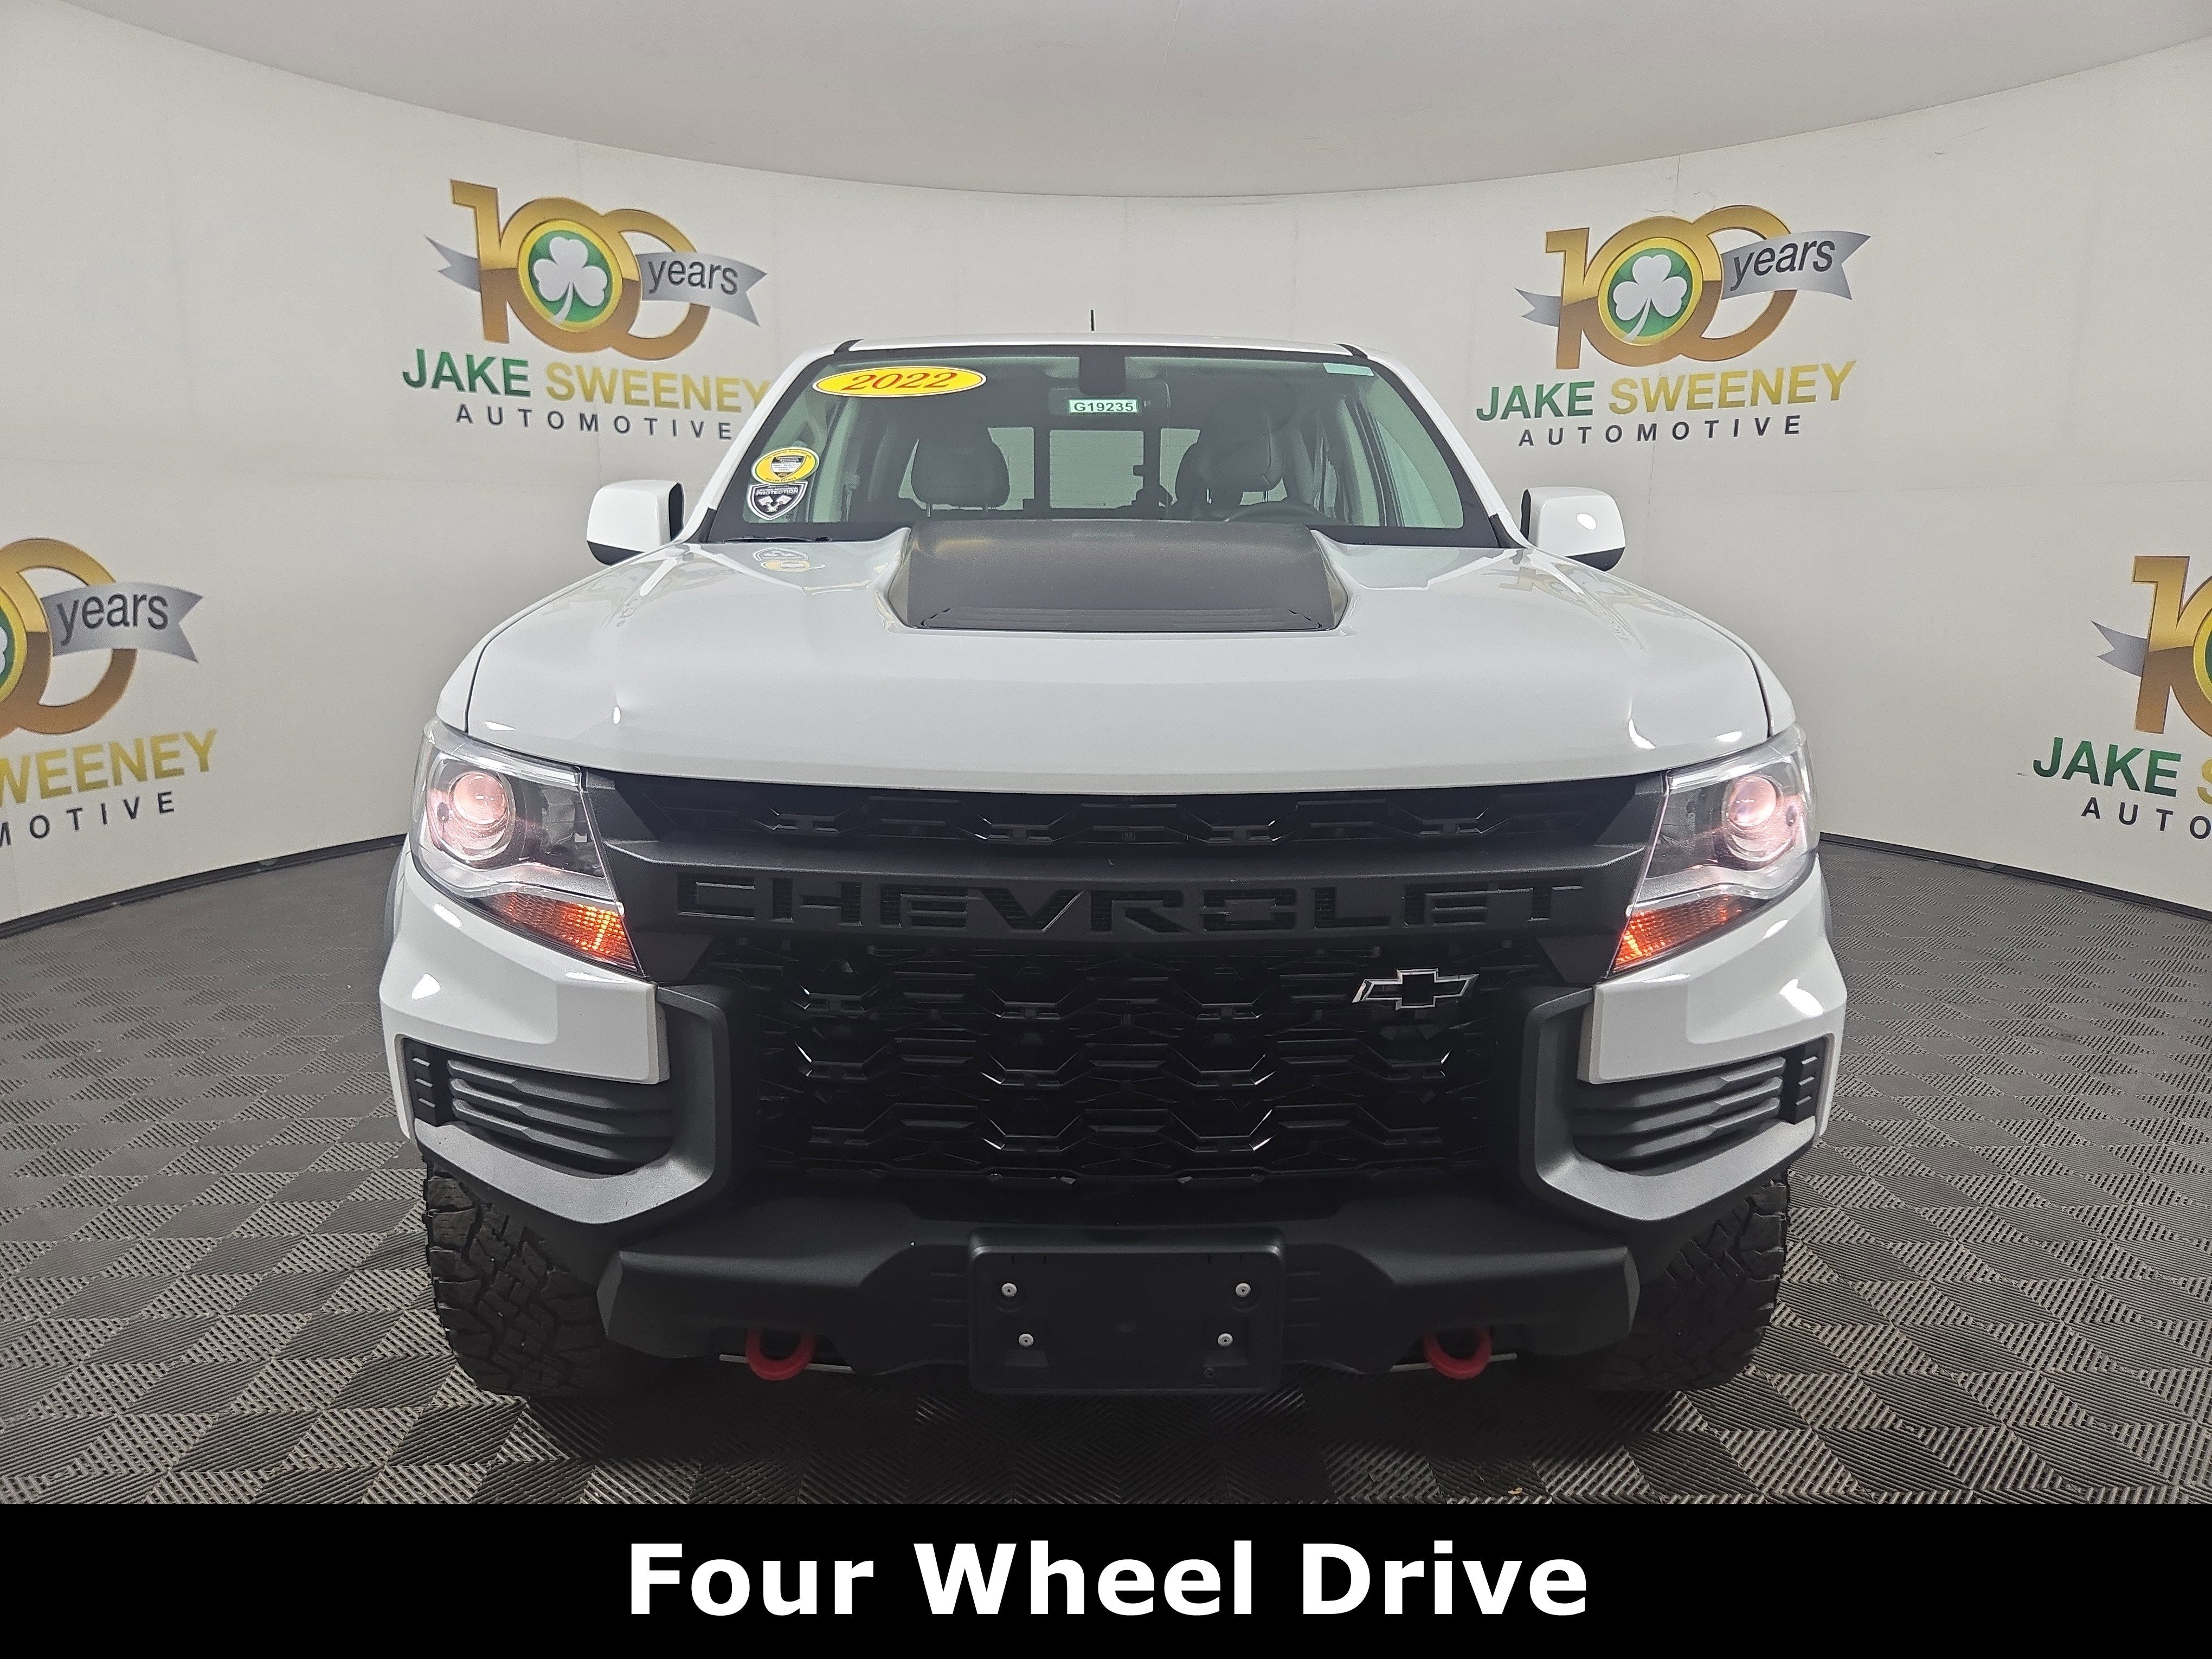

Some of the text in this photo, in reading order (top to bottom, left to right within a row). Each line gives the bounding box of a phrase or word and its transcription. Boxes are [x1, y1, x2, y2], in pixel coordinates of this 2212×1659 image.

[449, 179, 738, 361] 100 years
[1545, 204, 1836, 370] 100 years
[402, 348, 771, 414] JAKE SWEENEY
[840, 372, 957, 391] 2022
[1074, 402, 1134, 411] G19235
[1476, 360, 1856, 421] JAKE SWEENEY
[456, 403, 732, 440] AUTOMOTIVE
[1518, 415, 1801, 447] AUTOMOTIVE
[56, 593, 169, 646] years
[2033, 737, 2182, 798] JAKE
[677, 873, 1583, 934] CHEVROLET
